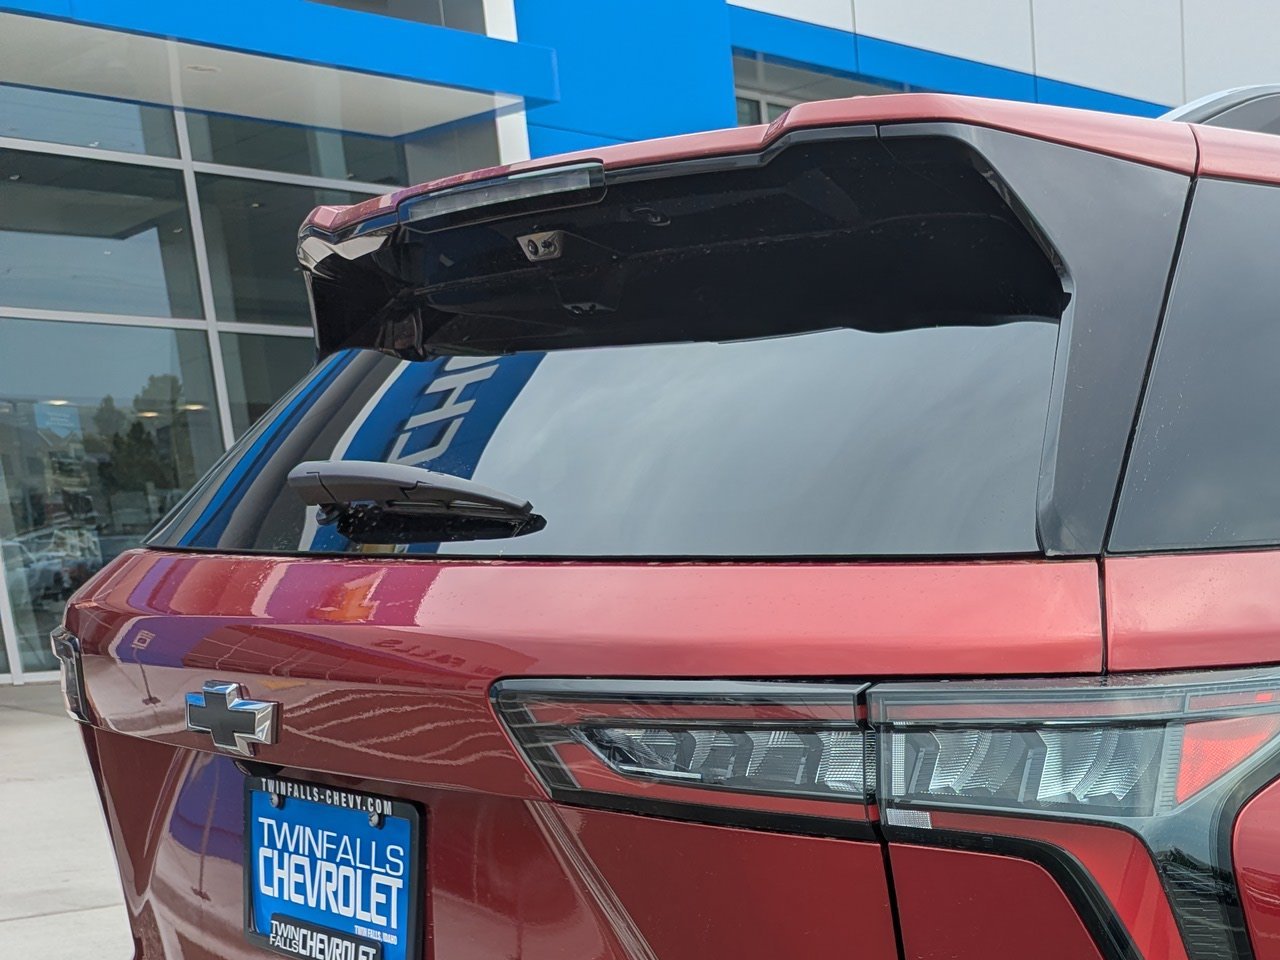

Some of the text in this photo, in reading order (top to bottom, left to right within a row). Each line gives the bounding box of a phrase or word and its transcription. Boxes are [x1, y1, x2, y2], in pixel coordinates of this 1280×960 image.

[261, 778, 393, 816] TWINFALLS-CHEVY.COM
[258, 846, 404, 930] CHEVROLET
[269, 934, 299, 953] FALLS
[270, 920, 299, 941] TWIN
